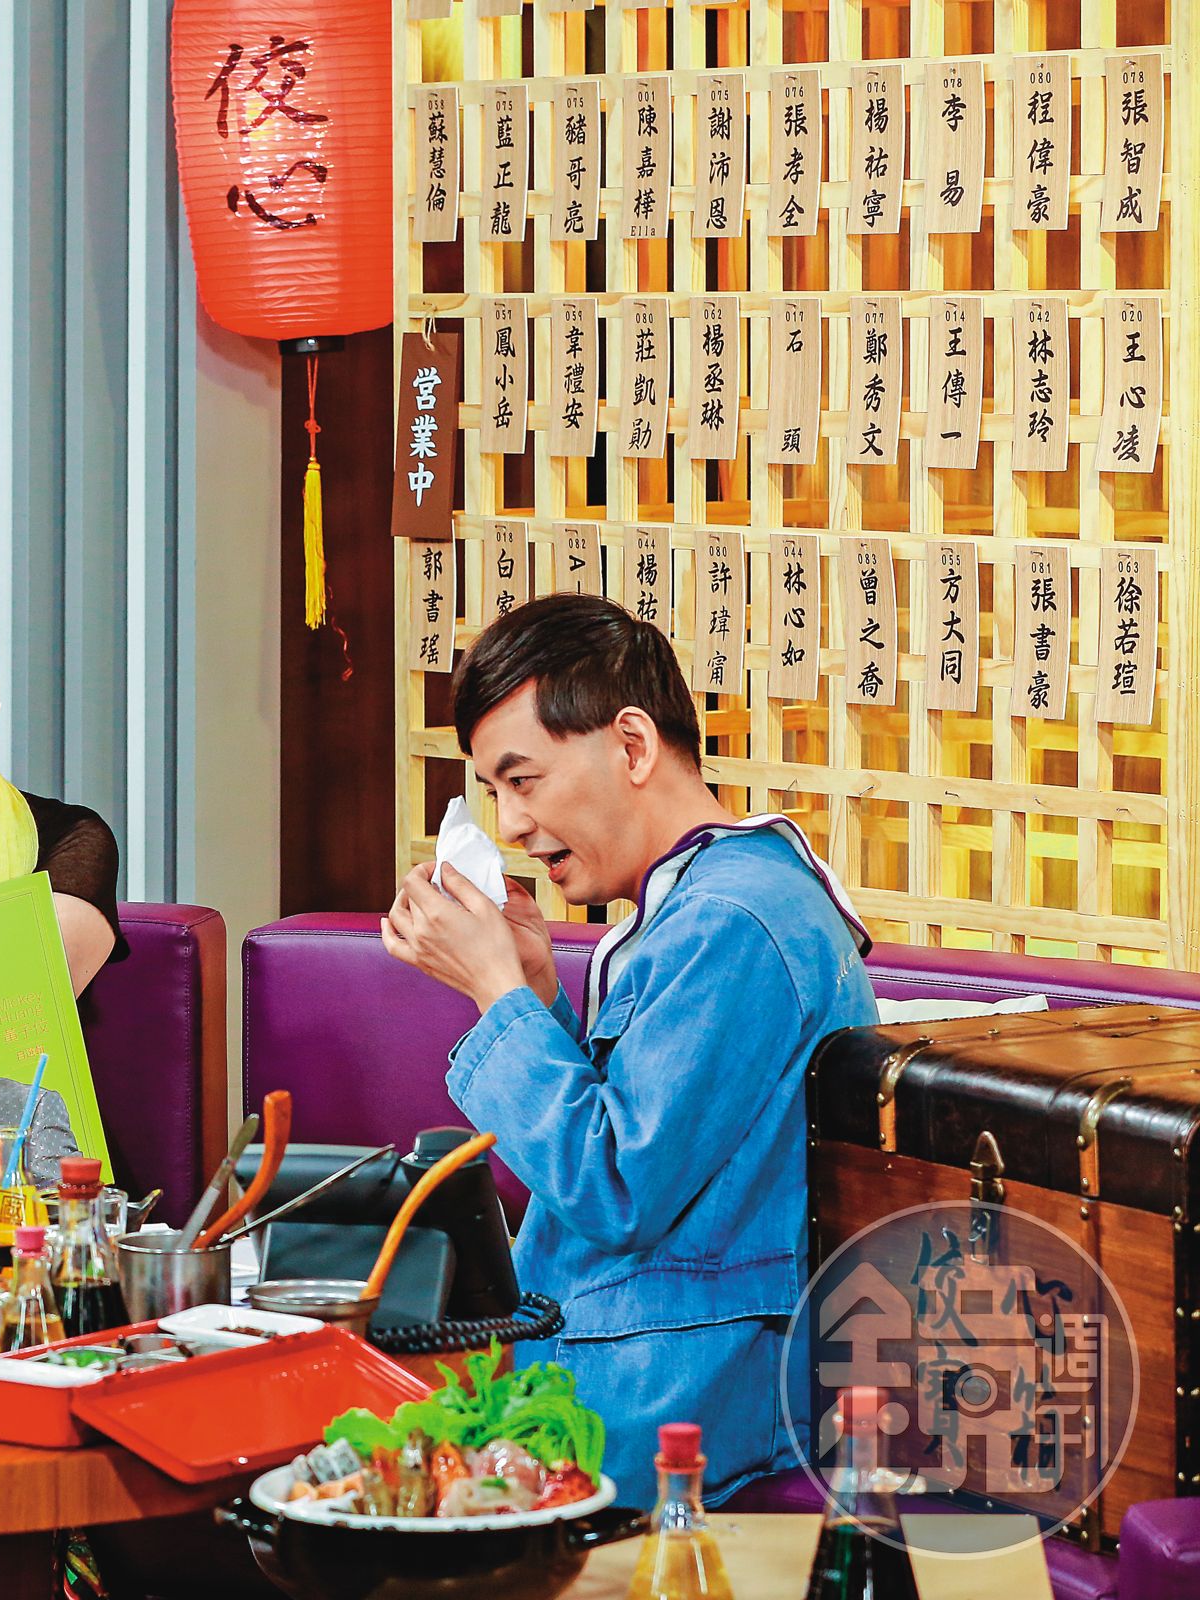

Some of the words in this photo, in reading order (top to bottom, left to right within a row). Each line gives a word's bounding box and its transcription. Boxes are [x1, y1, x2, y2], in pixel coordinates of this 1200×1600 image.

[943, 77, 963, 89] 078
[1029, 71, 1052, 84] 080
[1122, 70, 1144, 85] 078
[785, 85, 804, 98] 076
[866, 81, 887, 94] 076
[566, 96, 584, 109] 075
[637, 90, 655, 103] 001
[710, 89, 729, 102] 075
[495, 100, 513, 112] 075
[204, 35, 329, 230] 佼心
[939, 93, 967, 207] 李易
[1026, 90, 1055, 224] 程偉豪
[1116, 88, 1149, 224] 張智成
[425, 110, 449, 213] 蘇慧倫
[633, 105, 659, 220] 陳嘉樺
[706, 106, 733, 230] 謝沛恩
[778, 102, 809, 229] 張孝全
[862, 97, 889, 228] 楊祐寧
[490, 114, 515, 235] 藍正龍
[563, 113, 587, 234] 豬哥亮
[630, 225, 656, 237] Ella
[635, 312, 654, 324] 080
[703, 308, 722, 320] 062
[785, 310, 804, 323] 017
[865, 312, 884, 324] 077
[945, 310, 966, 322] 014
[1029, 310, 1050, 323] 042
[1121, 310, 1143, 322] 020
[561, 325, 585, 429] 韋禮安
[700, 323, 725, 432] 楊丞琳
[940, 326, 968, 440] 王傳一
[781, 329, 804, 454] 石頭
[859, 328, 888, 457] 鄭秀文
[1027, 328, 1055, 443] 林志玲
[1112, 331, 1146, 463] 王心凌
[496, 531, 514, 543] 018
[568, 537, 587, 550] 082
[637, 537, 656, 550] 044
[709, 545, 727, 558] 080
[783, 546, 803, 559] 044
[857, 553, 877, 565] 083
[941, 553, 961, 566] 055
[1031, 561, 1051, 574] 081
[1118, 561, 1139, 574] 063
[419, 546, 444, 665] 郭書瑤
[781, 561, 807, 667] 林心如
[857, 567, 885, 699] 曾之喬
[939, 568, 965, 685] 方大同
[1111, 576, 1143, 695] 徐若瑄
[1027, 577, 1057, 710] 張書豪
